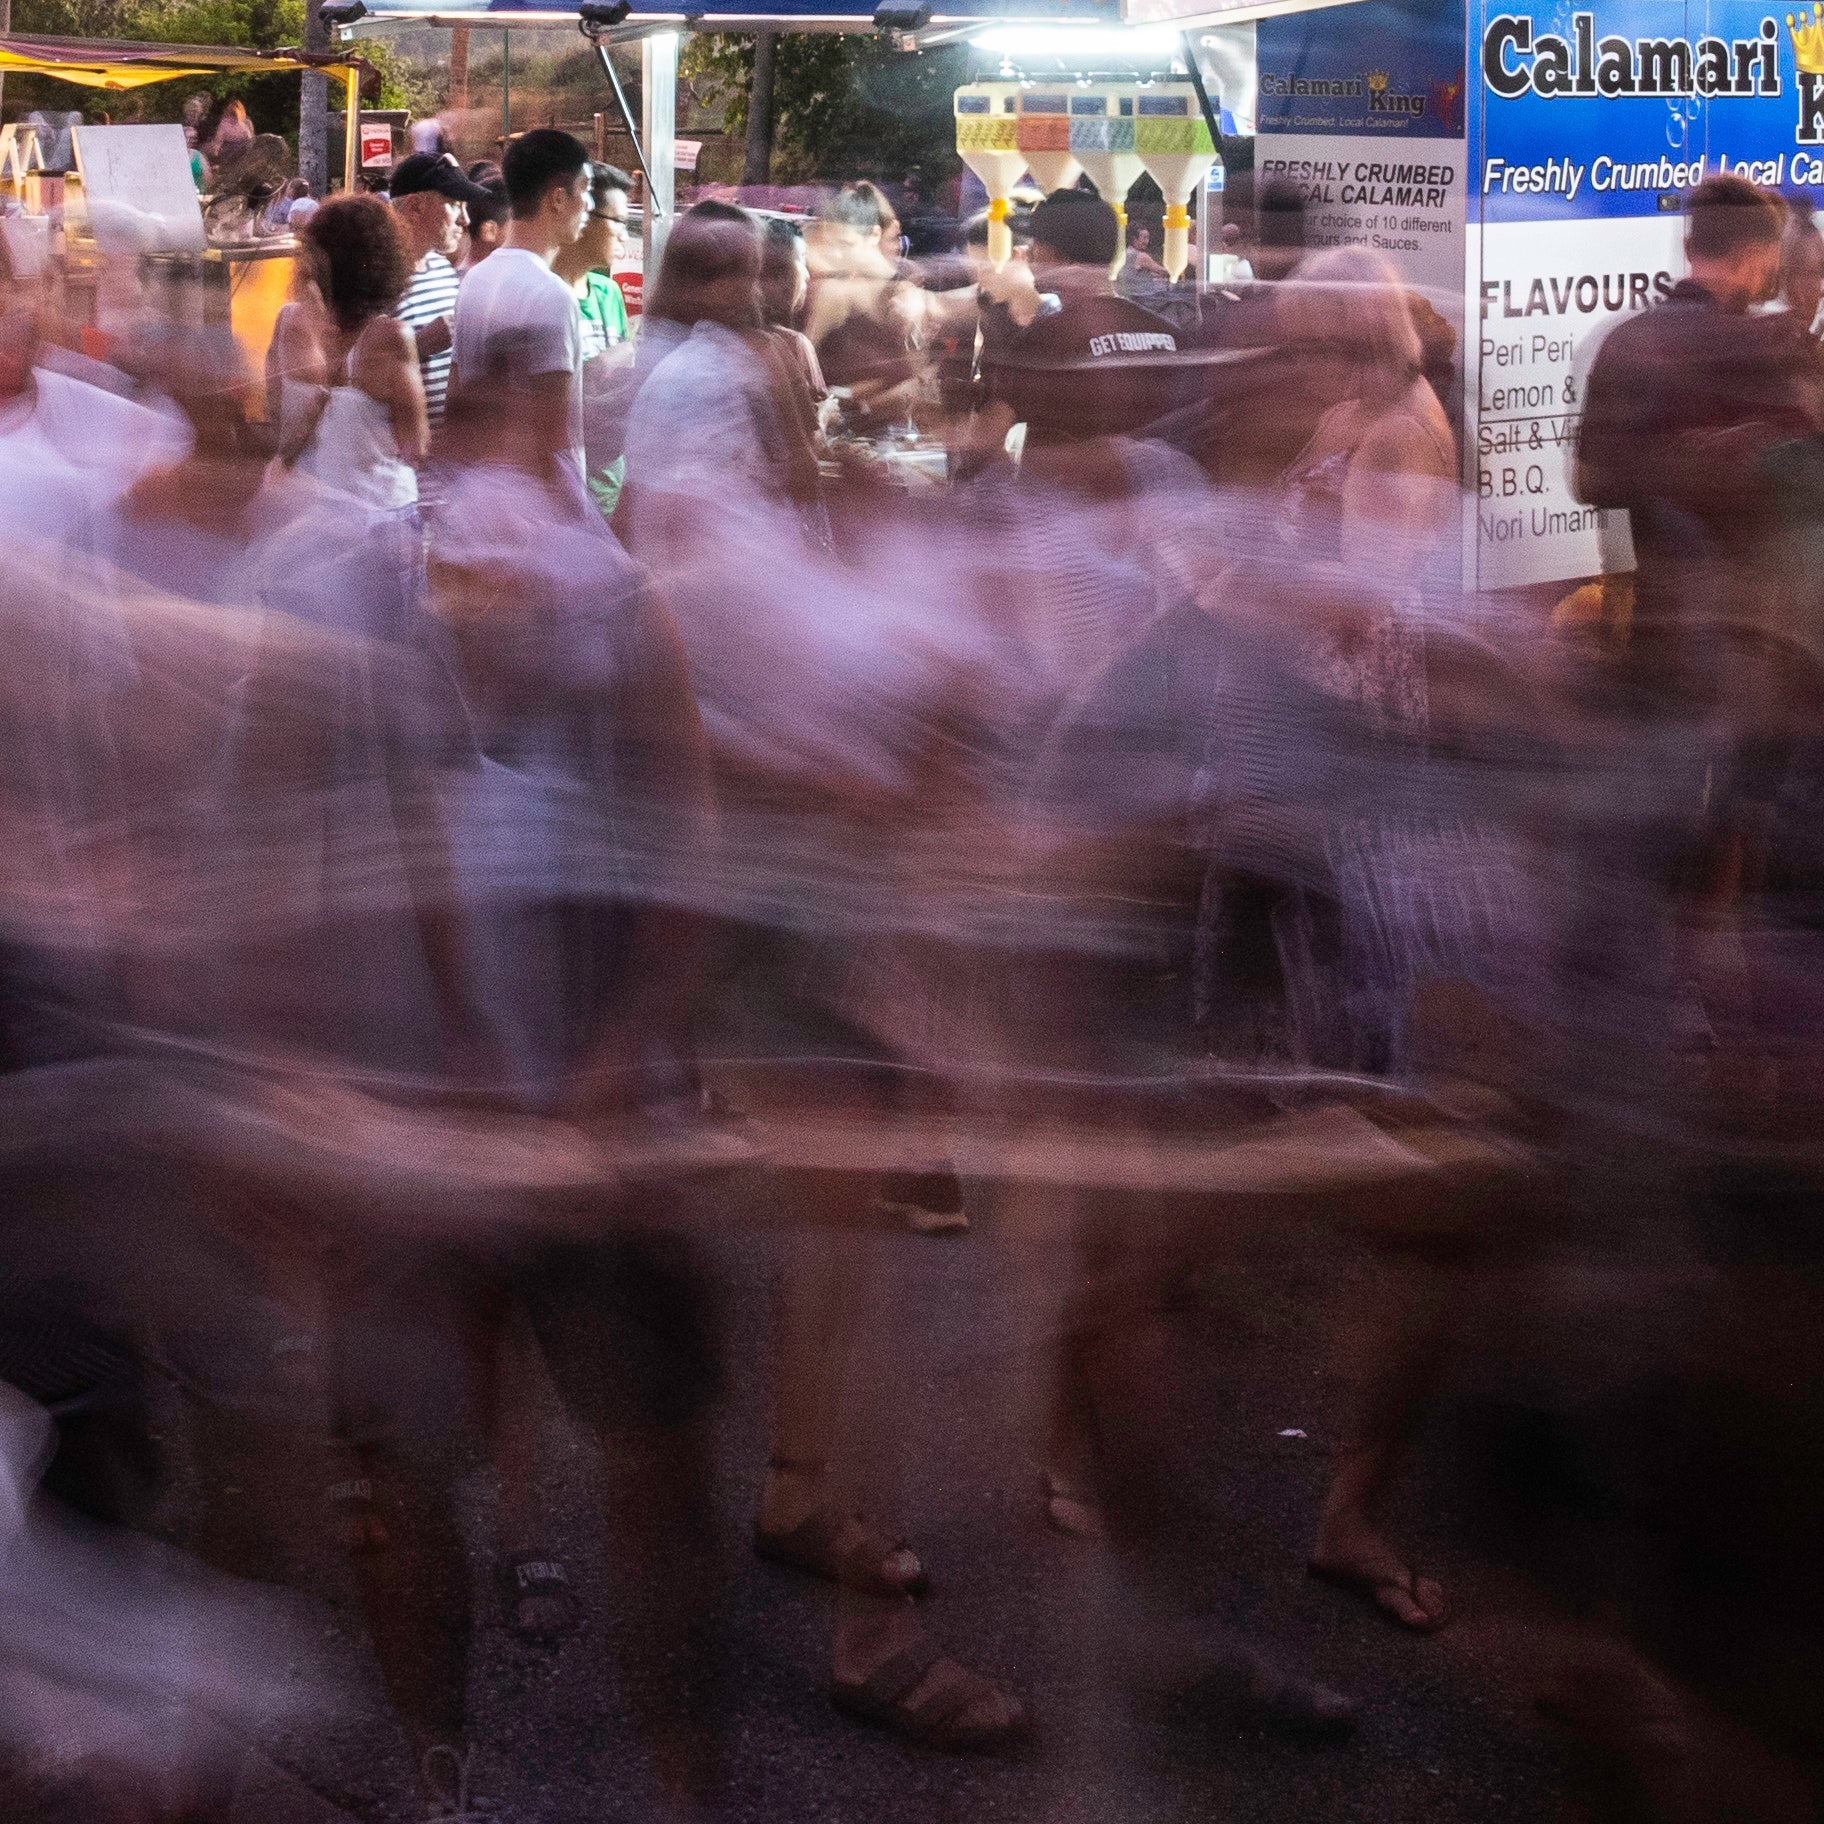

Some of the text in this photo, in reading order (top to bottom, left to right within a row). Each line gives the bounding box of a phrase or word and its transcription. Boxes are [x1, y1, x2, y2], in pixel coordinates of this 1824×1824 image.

[1483, 12, 1780, 99] Calamari
[1259, 72, 1427, 118] Calamari King
[1261, 160, 1455, 186] FRESHLY CRUMBED
[1482, 158, 1584, 200] Freshly
[1341, 184, 1446, 209] CALAMARI
[1320, 215, 1362, 228] choice
[1365, 215, 1380, 229] of
[1382, 216, 1397, 231] 10
[1401, 217, 1452, 234] different
[1372, 234, 1422, 251] Sauces.
[1480, 271, 1672, 320] FLAVOURS
[1089, 334, 1117, 356] GET
[1480, 332, 1574, 367] Peri Peri
[1479, 376, 1577, 413] Lemon &
[1478, 422, 1522, 456] Salt
[1528, 421, 1543, 450] &
[1478, 465, 1550, 499] B.B.Q.
[1476, 510, 1523, 544] Nori
